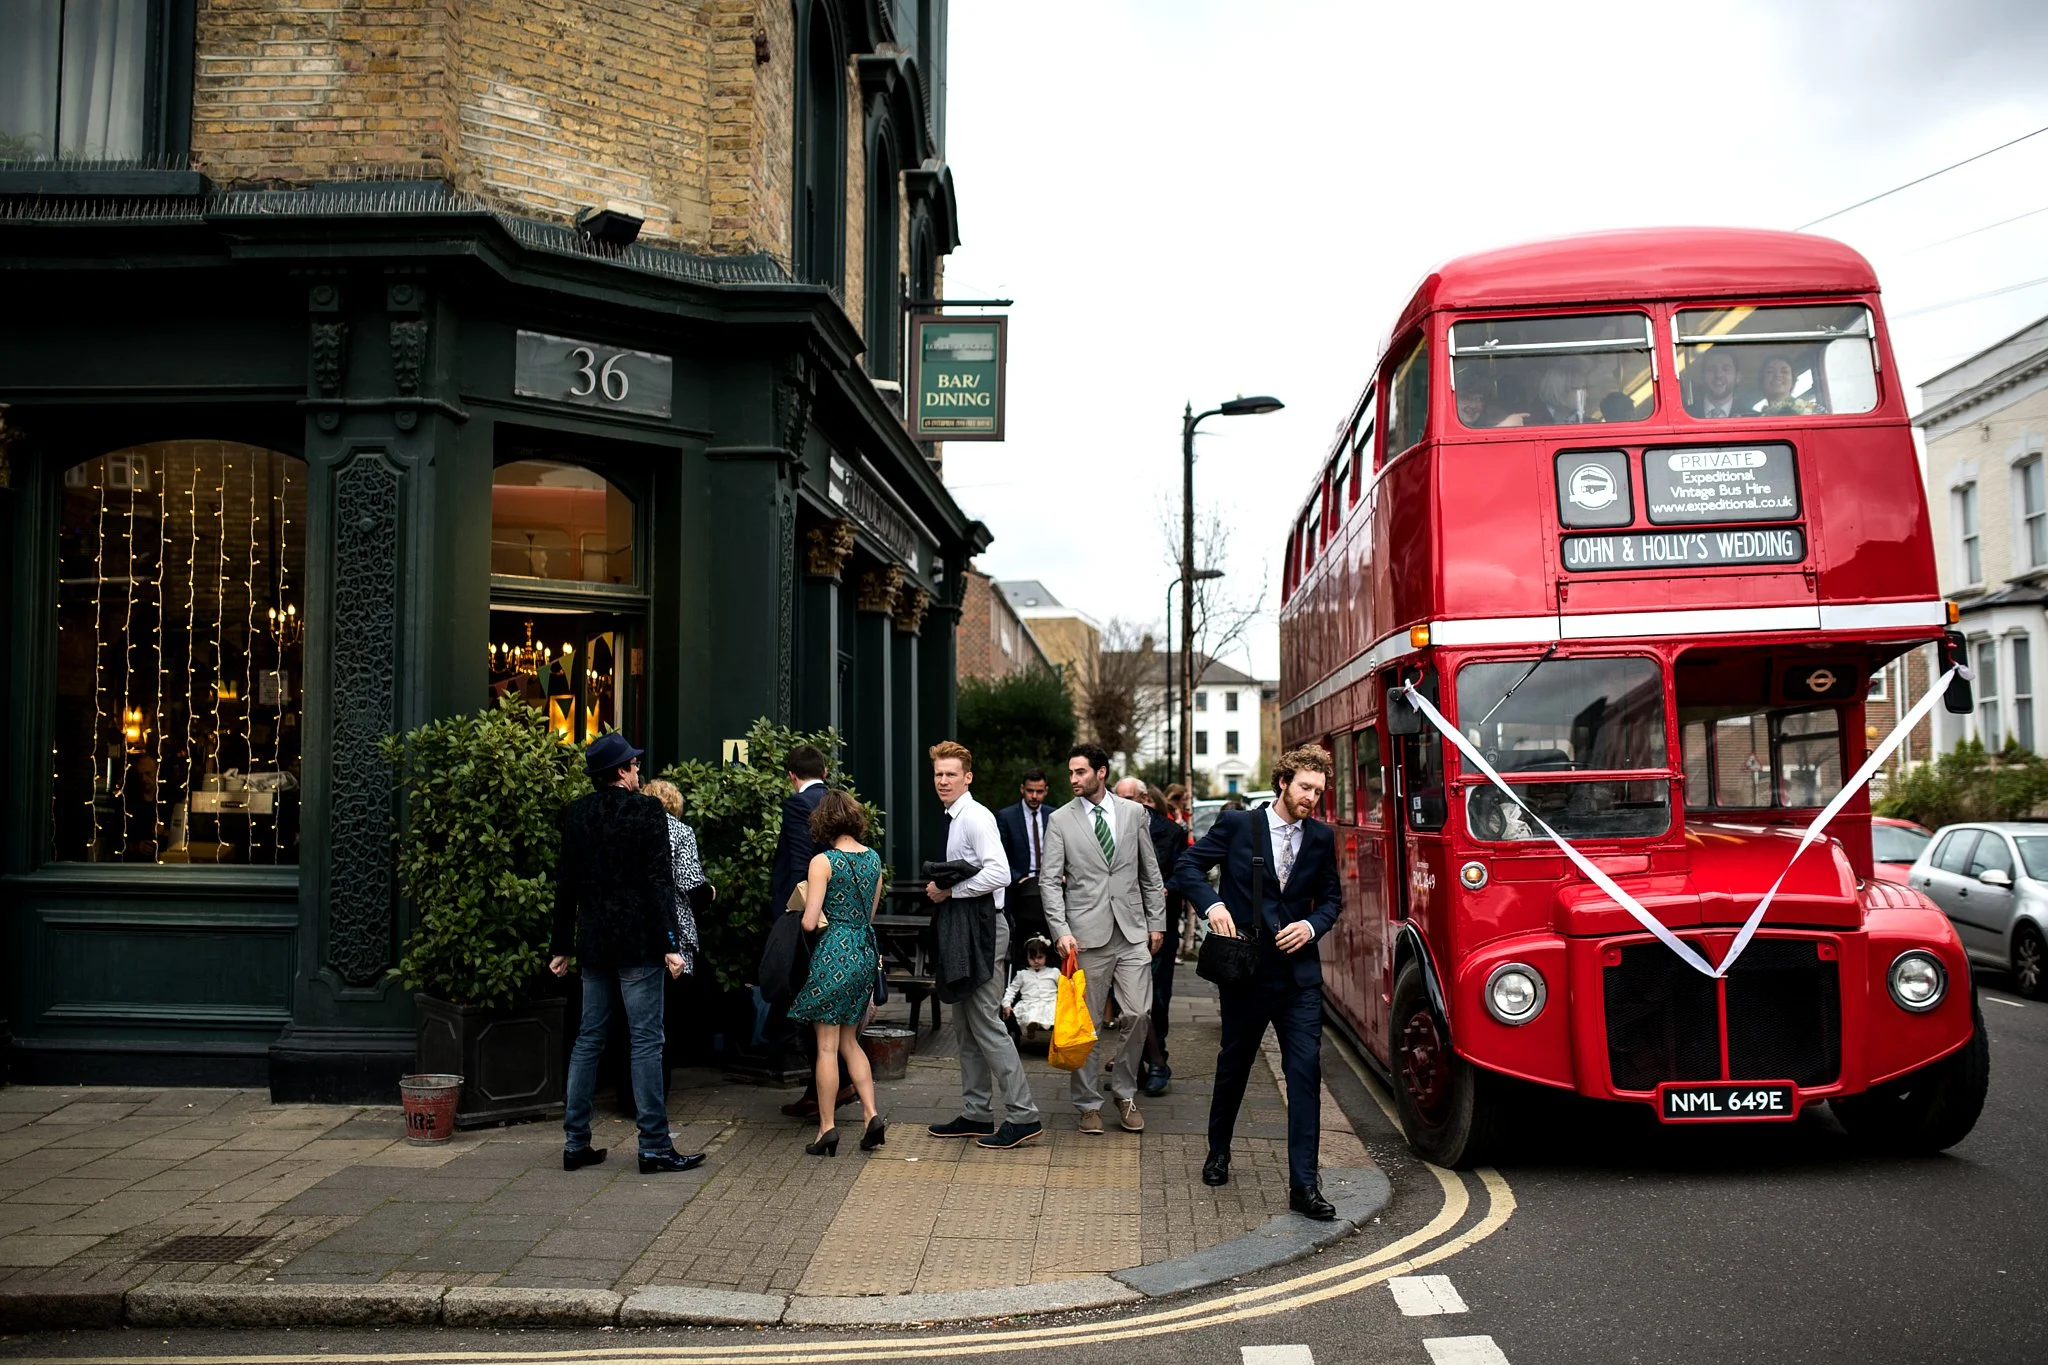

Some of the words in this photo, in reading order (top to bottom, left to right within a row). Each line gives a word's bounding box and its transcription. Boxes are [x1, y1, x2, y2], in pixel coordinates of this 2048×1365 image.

[570, 347, 630, 401] 36
[938, 374, 980, 388] BAR/
[926, 392, 990, 407] DINING
[1680, 452, 1755, 468] PRIVATE
[1682, 469, 1756, 486] Expeditional
[1670, 486, 1716, 500] Vintage
[1719, 484, 1742, 496] Bus
[1746, 483, 1772, 495] Hire
[1652, 496, 1793, 513] www.expeditional.co.uk
[1569, 537, 1614, 564] JOHN
[1622, 536, 1635, 562] &
[1642, 534, 1709, 561] HOLLY'S
[1716, 531, 1793, 558] WEDDING
[1671, 1092, 1722, 1112] NML
[1728, 1091, 1784, 1110] 649E
